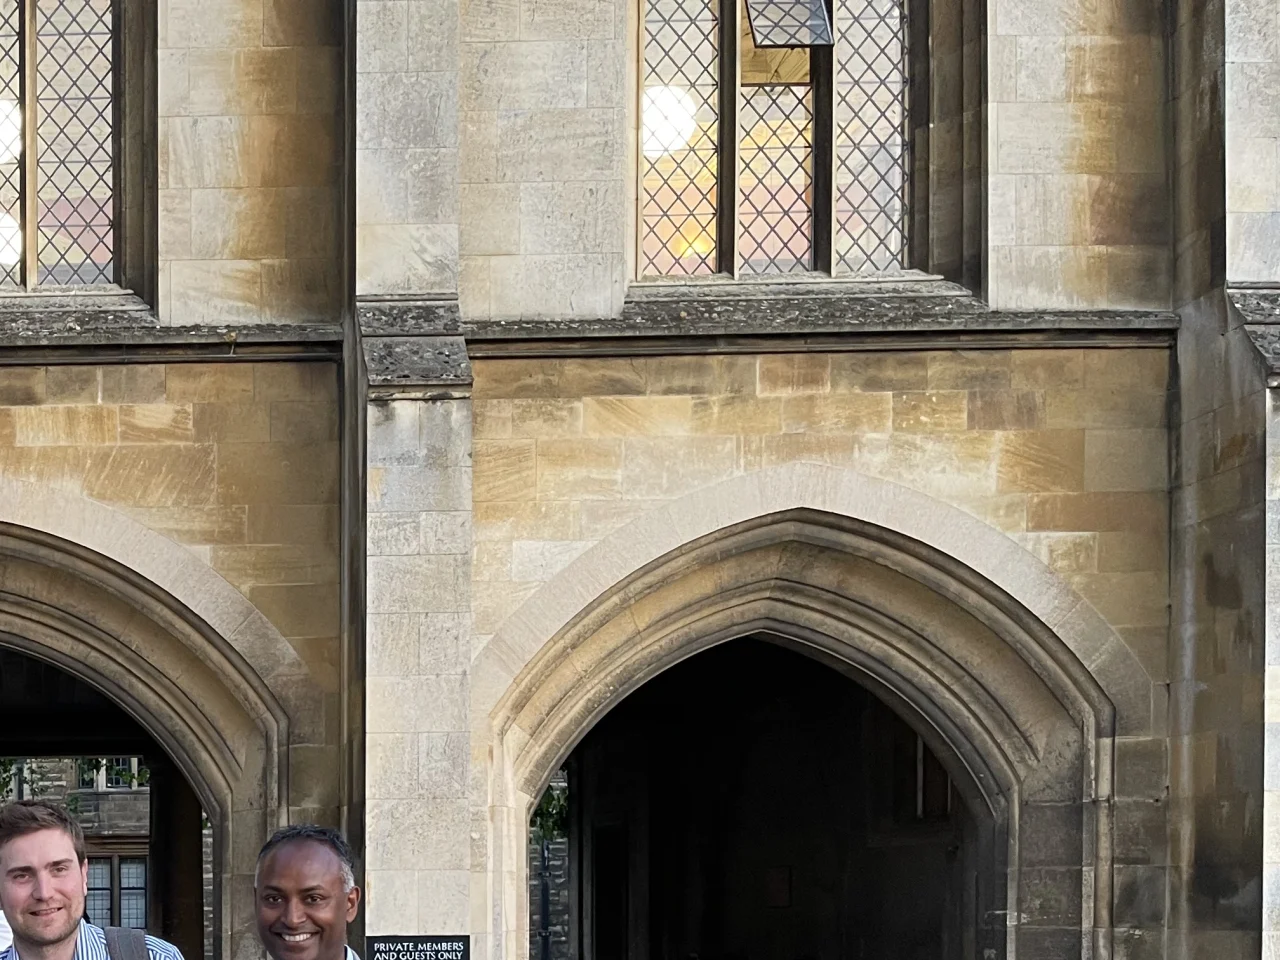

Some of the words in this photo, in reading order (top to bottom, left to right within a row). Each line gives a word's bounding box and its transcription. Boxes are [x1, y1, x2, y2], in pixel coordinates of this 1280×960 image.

[374, 942, 414, 951] PRIVATE
[417, 942, 464, 951] MEMBERS
[374, 952, 397, 960] AND
[399, 952, 436, 960] GUESTS
[438, 952, 463, 960] ONLY
